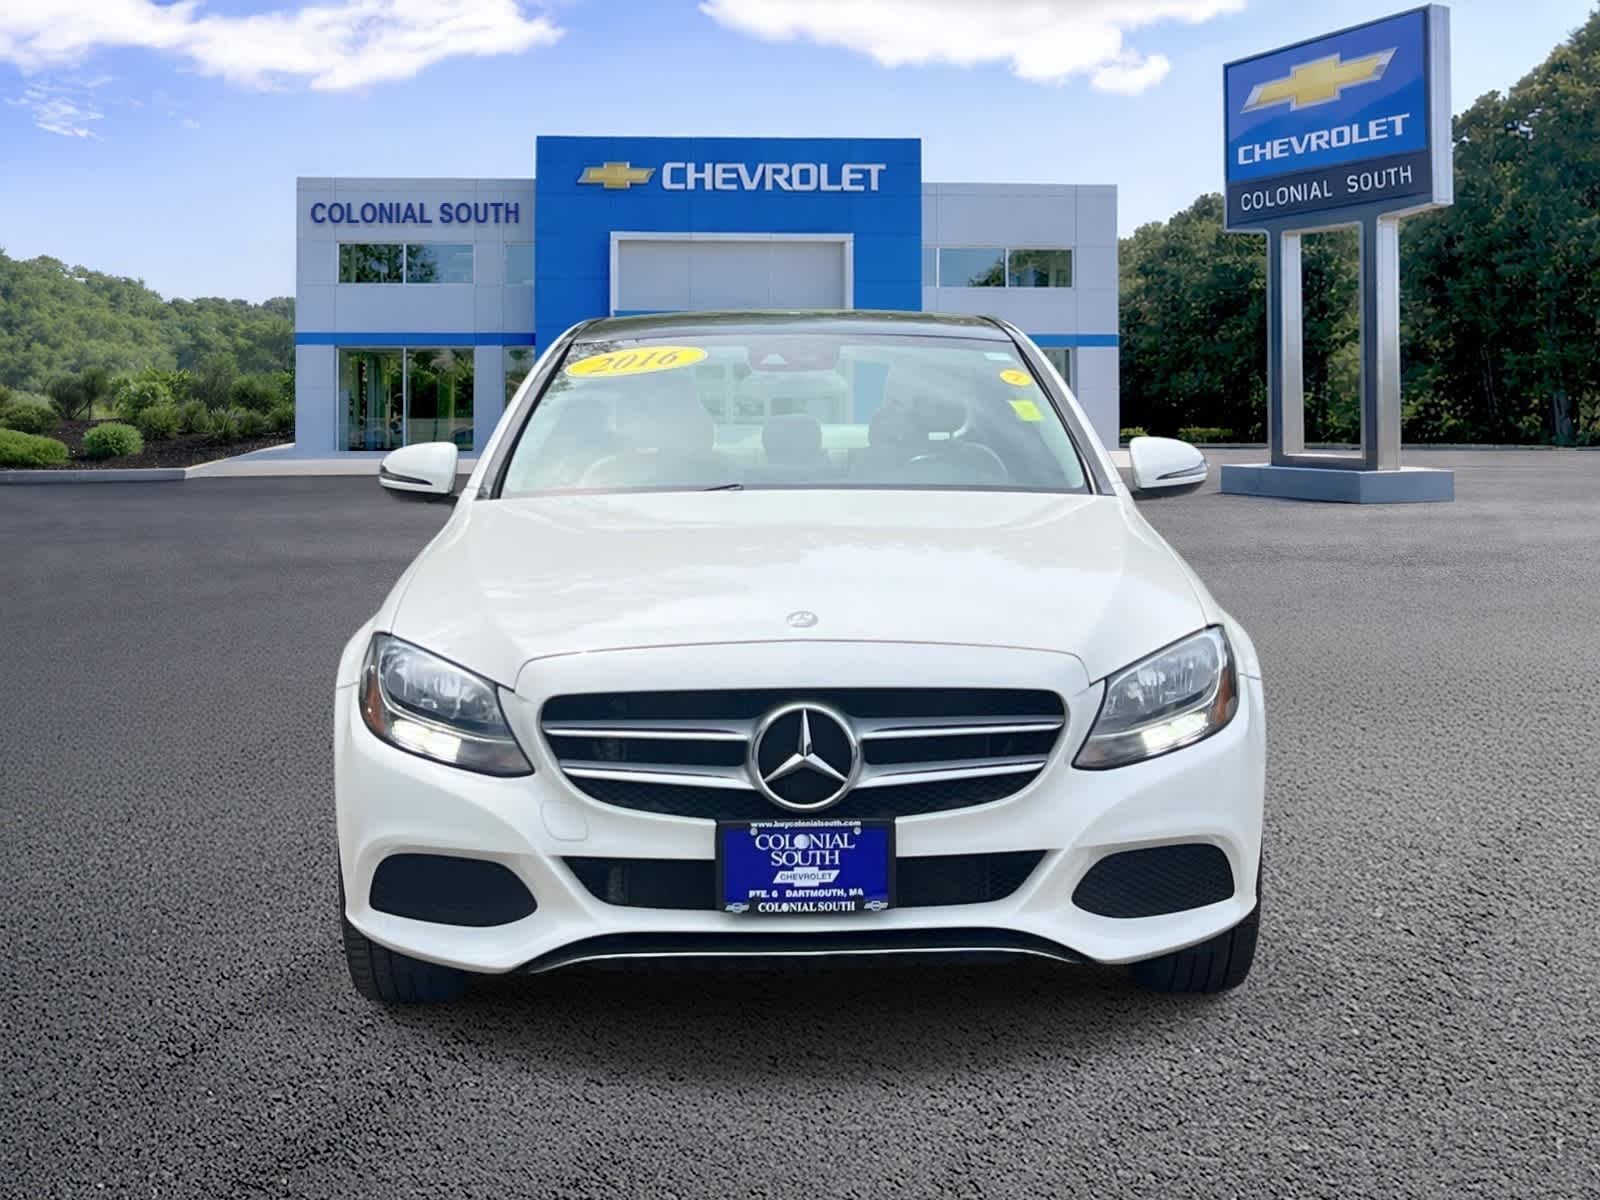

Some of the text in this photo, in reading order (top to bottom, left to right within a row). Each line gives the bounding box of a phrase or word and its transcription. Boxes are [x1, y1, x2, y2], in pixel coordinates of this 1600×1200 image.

[1237, 113, 1410, 165] CHEVROLET
[661, 161, 886, 193] CHEVROLET
[1240, 165, 1413, 212] COLONIAL SOUTH
[310, 202, 520, 225] COLONIAL SOUTH
[587, 350, 679, 373] 2016
[755, 833, 856, 850] COLONIAL
[770, 850, 840, 866] SOUTH
[780, 871, 834, 881] CHEVROLET
[785, 889, 847, 898] DARTMOUTH,
[757, 901, 856, 913] COLONIAL SOUTH
